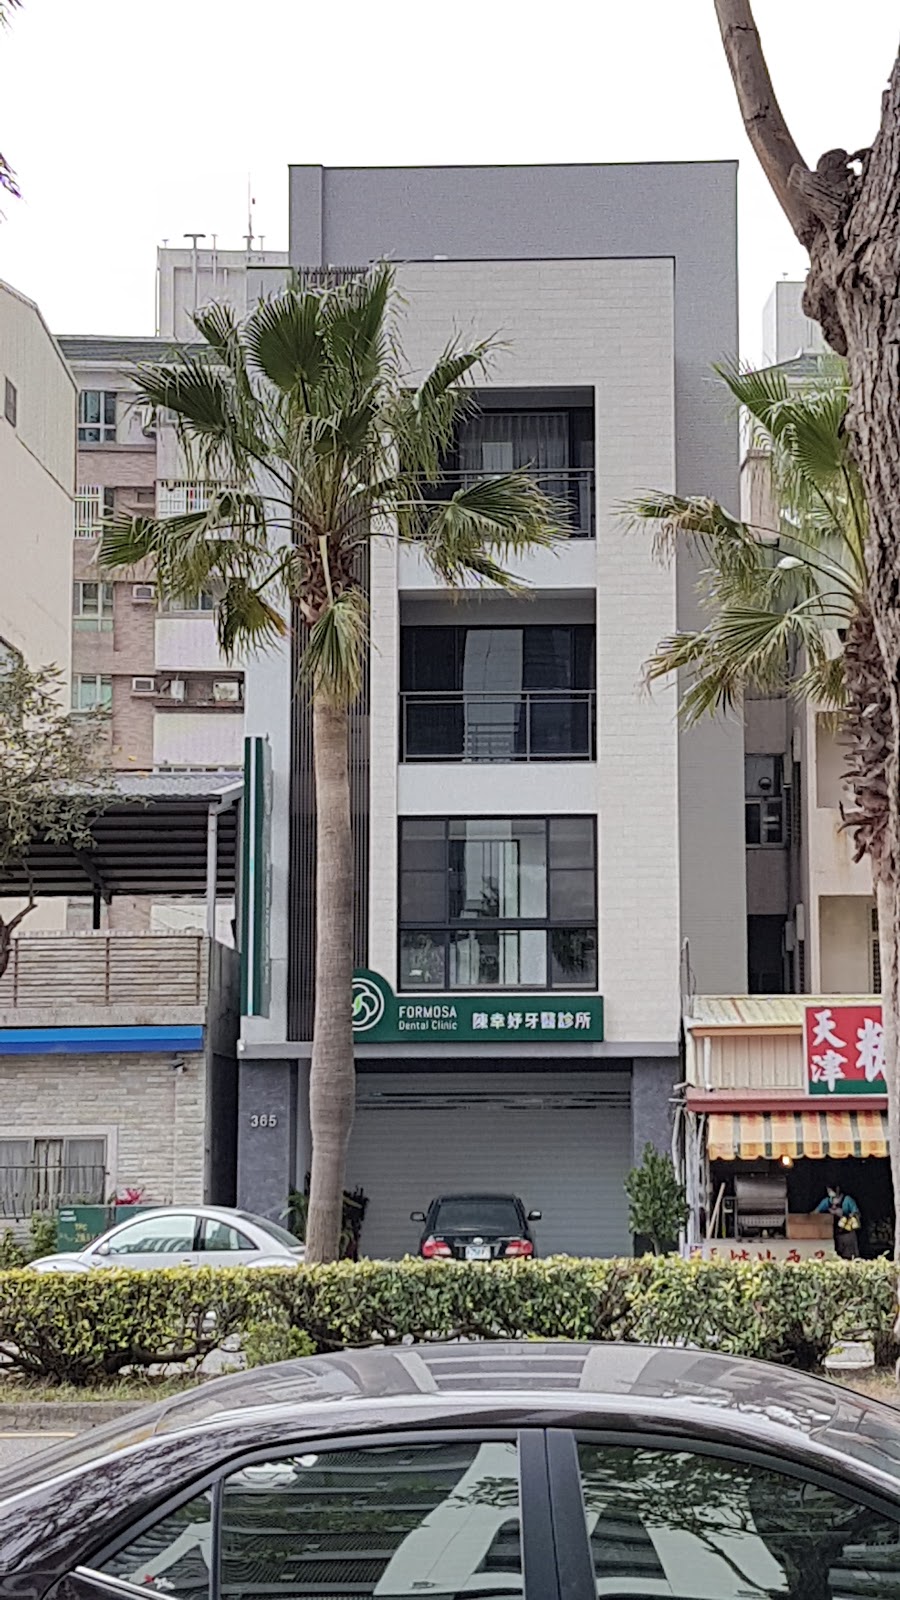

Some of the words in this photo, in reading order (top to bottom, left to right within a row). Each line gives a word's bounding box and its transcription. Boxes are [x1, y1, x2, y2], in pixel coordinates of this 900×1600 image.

[399, 1005, 458, 1019] FORMOSA
[398, 1020, 429, 1031] Dental
[431, 1020, 458, 1031] Clinic
[810, 1009, 848, 1093] 天津
[250, 1114, 277, 1128] 365
